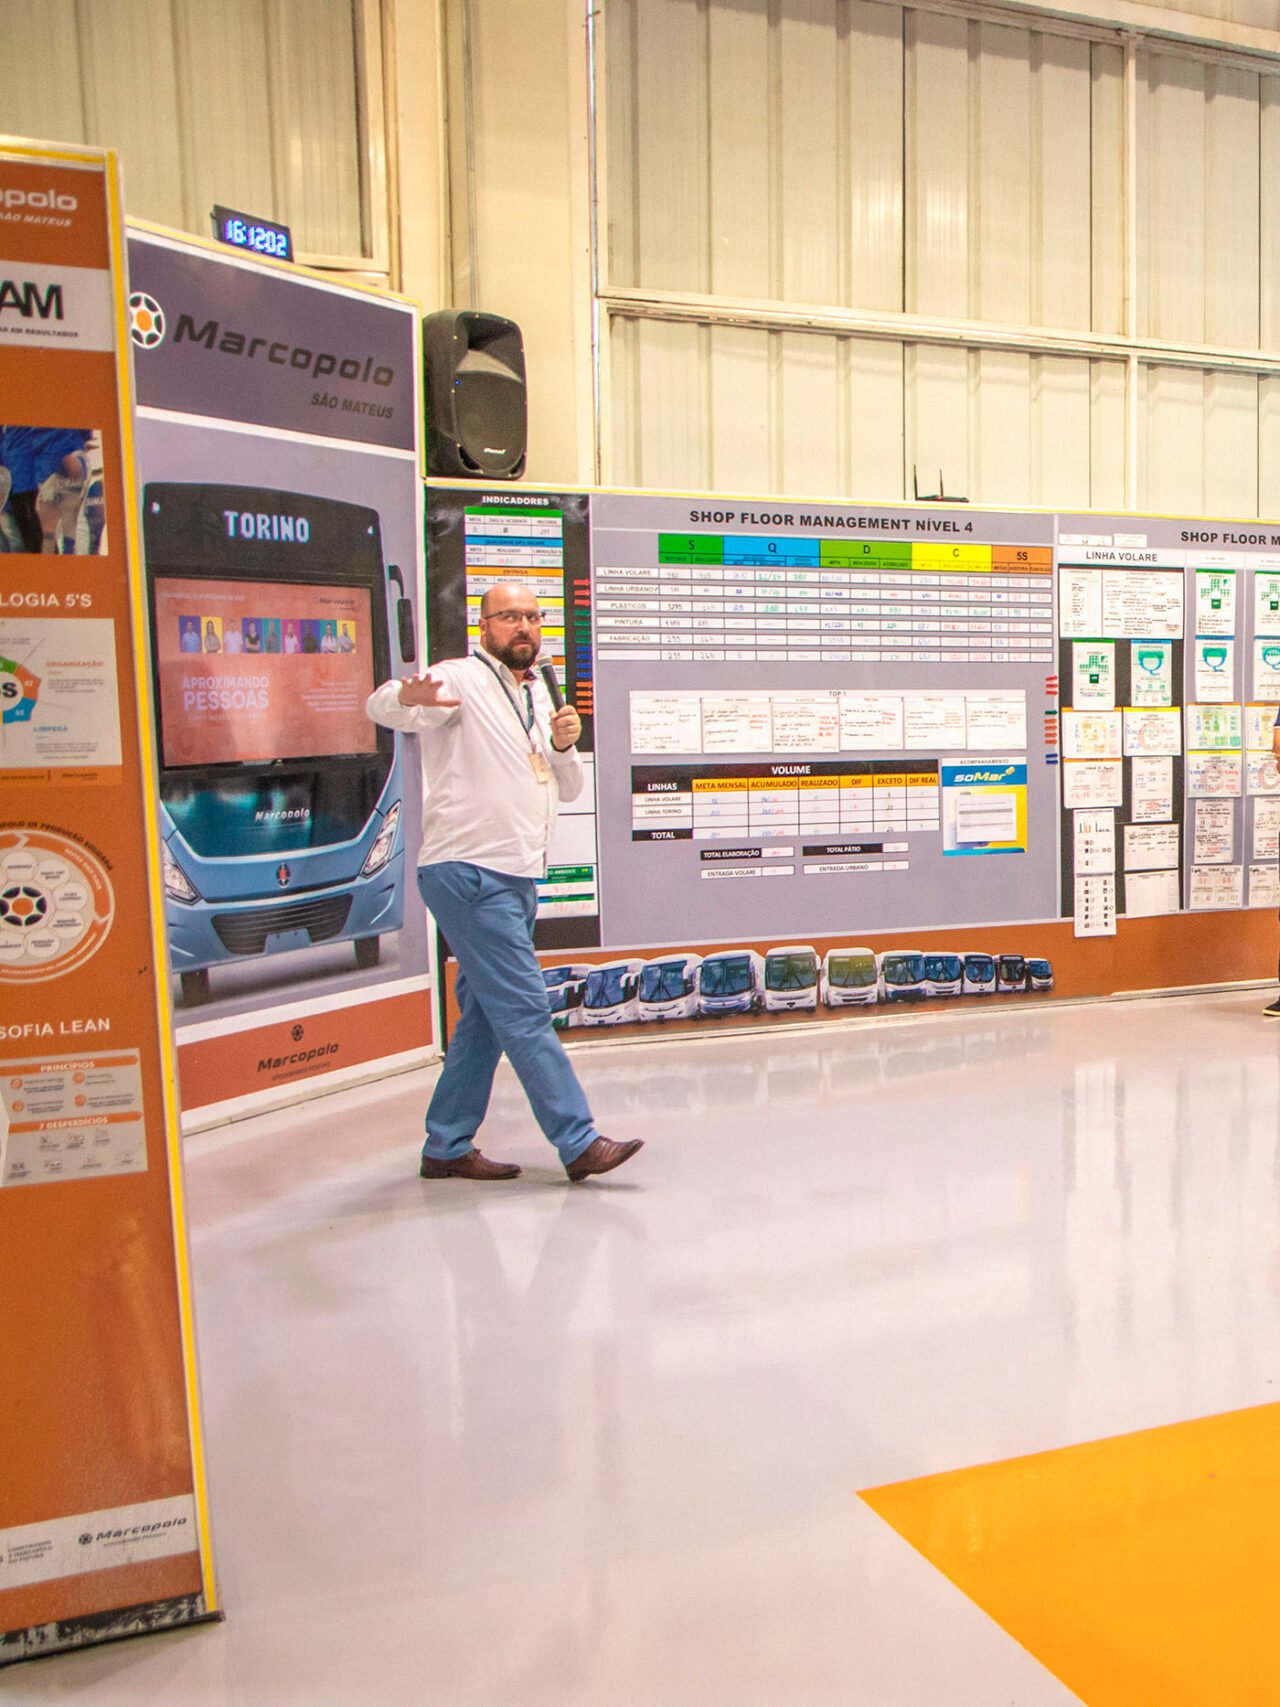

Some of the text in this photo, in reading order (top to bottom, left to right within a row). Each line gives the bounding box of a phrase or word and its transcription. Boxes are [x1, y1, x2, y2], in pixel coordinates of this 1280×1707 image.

[24, 214, 72, 227] MATEUS
[173, 313, 395, 388] Marcopolo
[311, 392, 394, 419] SÃO MATEUS
[482, 495, 550, 506] INDICADORES
[224, 510, 310, 544] TORINO
[690, 510, 973, 533] SHOP FLOOR MANAGEMENT NÍVEL 4
[1180, 531, 1218, 543] SHOP
[1223, 533, 1267, 545] FLOOR
[688, 540, 695, 551] S
[768, 543, 777, 554] Q
[863, 545, 871, 554] D
[952, 548, 960, 557] C
[1016, 551, 1028, 561] 5S
[1085, 551, 1158, 562] LINHA VOLARE
[625, 569, 652, 577] VOLARE
[65, 593, 92, 608] 5'S
[182, 675, 270, 691] APROXIMANDO
[0, 681, 18, 698] S
[183, 690, 270, 712] PESSOAS
[771, 765, 811, 776] VOLUME
[800, 779, 838, 787] REALIZADO
[851, 777, 862, 785] DIF
[877, 776, 903, 785] EXCETO
[909, 776, 937, 785] DIF REAL
[954, 771, 1006, 784] soMar
[647, 782, 678, 792] LINHAS
[695, 781, 747, 790] META MENSAL
[750, 779, 798, 789] ACUMULADO
[255, 807, 310, 822] Marcopolo
[651, 832, 675, 840] TOTAL
[704, 848, 760, 859] TOTAL ELABORAÇÃO
[826, 846, 844, 854] TOTAL
[707, 868, 756, 877] ENTRADA VOLARE
[819, 864, 869, 873] ENTRADA URBANO
[60, 1017, 111, 1035] LEAN
[257, 1043, 339, 1073] Marcopolo
[40, 1060, 95, 1073] PRINCÍPIOS
[47, 1116, 109, 1130] DESPERDÍCIOS
[96, 1517, 187, 1541] Marcopolo
